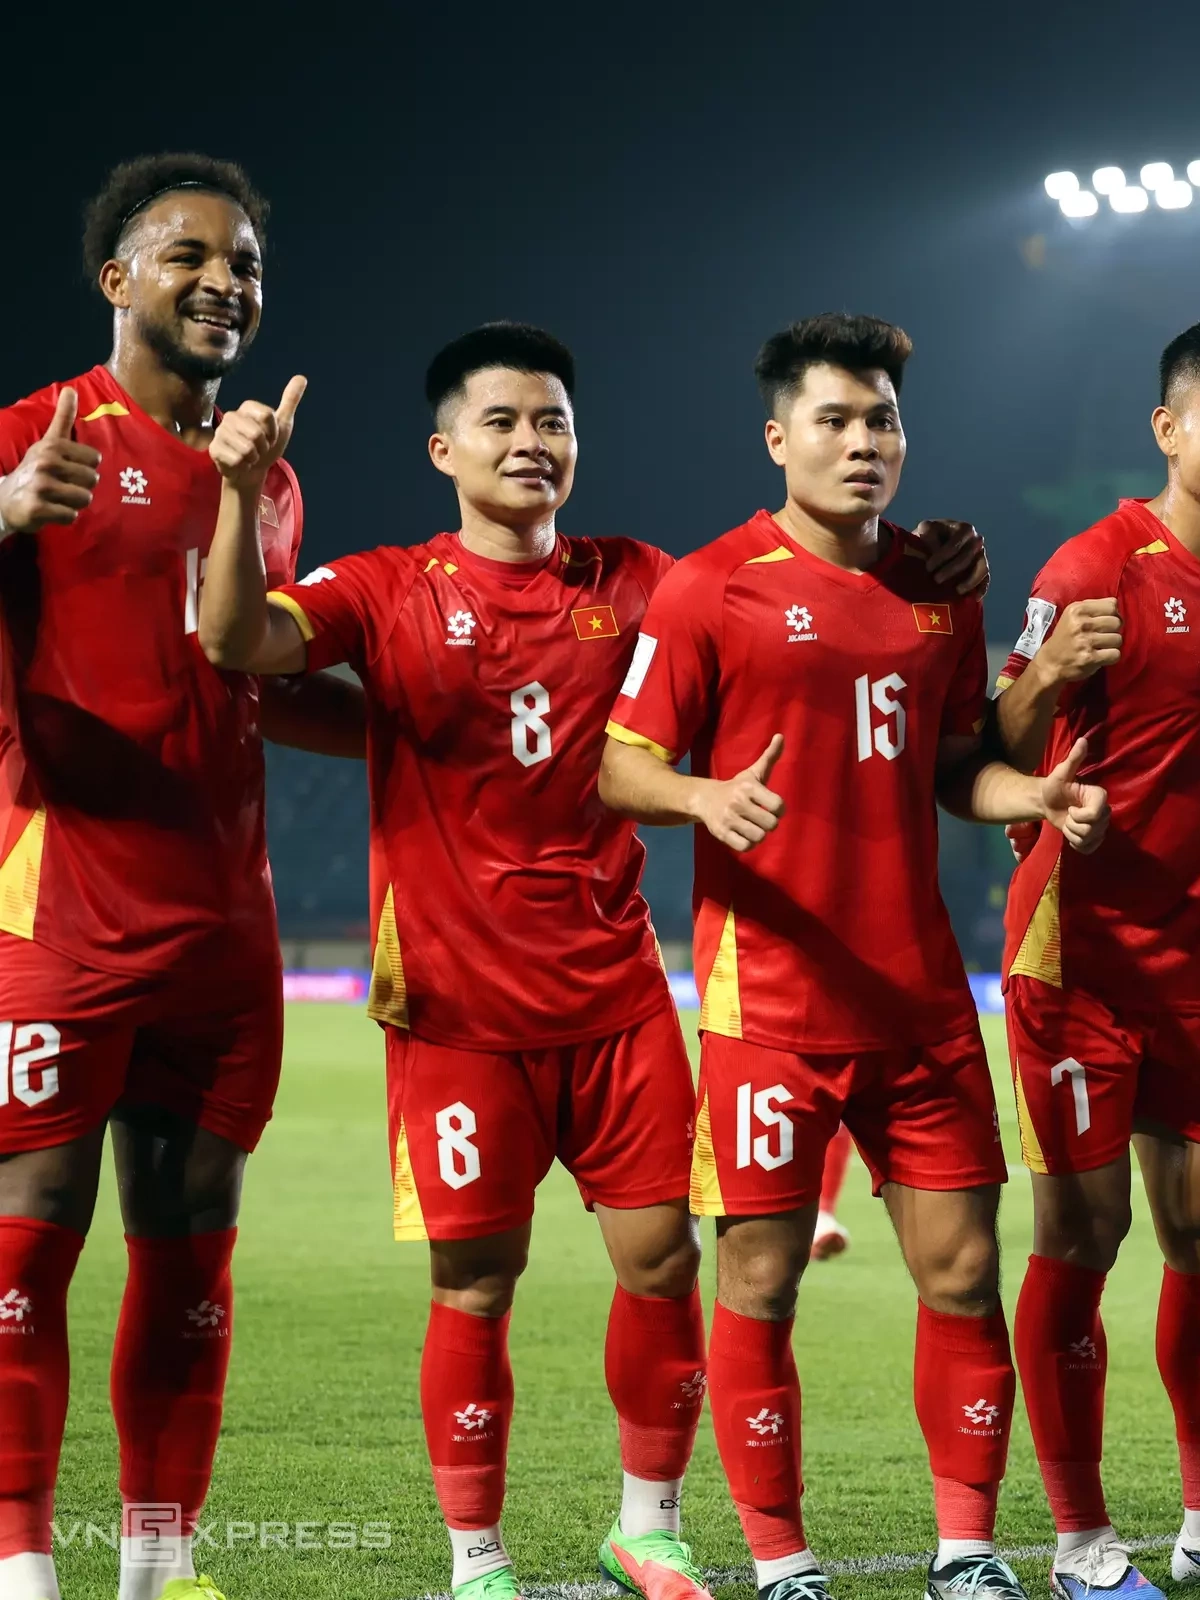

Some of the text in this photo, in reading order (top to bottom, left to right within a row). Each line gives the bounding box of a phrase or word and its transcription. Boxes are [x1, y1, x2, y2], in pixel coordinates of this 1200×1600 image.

[510, 680, 553, 768] 8
[854, 671, 908, 763] 15
[0, 1020, 61, 1108] 12
[1050, 1055, 1091, 1136] 7
[435, 1100, 481, 1191] 8
[735, 1081, 795, 1172] 15
